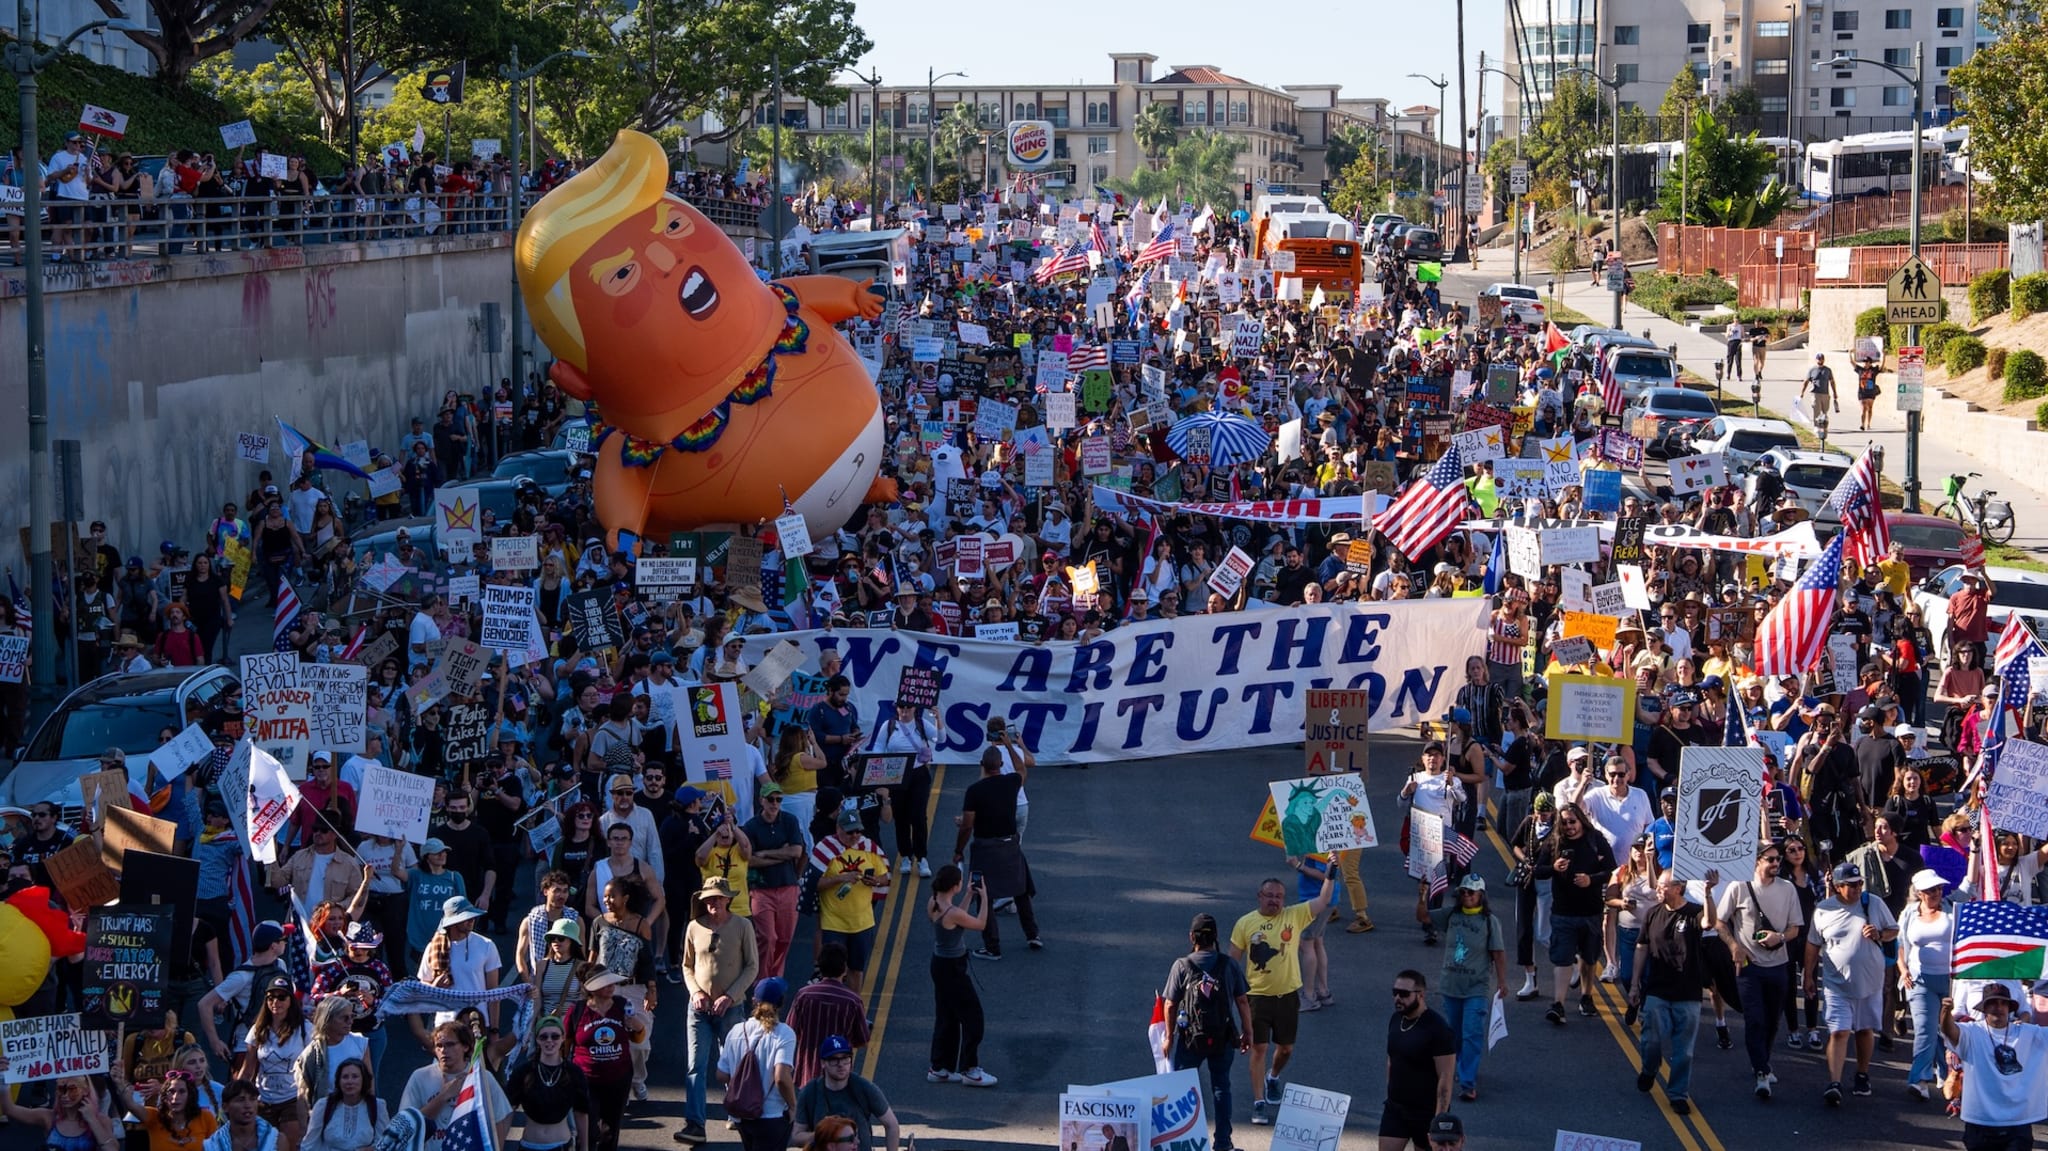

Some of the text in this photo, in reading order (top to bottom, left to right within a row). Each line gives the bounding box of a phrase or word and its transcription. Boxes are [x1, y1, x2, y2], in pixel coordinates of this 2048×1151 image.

[1014, 129, 1045, 143] BURGER
[1015, 138, 1047, 154] KING
[1512, 176, 1526, 185] 25
[6, 189, 22, 200] NO
[1892, 307, 1936, 318] AHEAD
[1240, 323, 1260, 333] NO
[1235, 336, 1259, 347] NAZI
[1236, 347, 1258, 357] KING
[1407, 376, 1424, 385] LIFE
[1407, 393, 1440, 402] JUSTICE
[239, 433, 269, 448] ABOLISH
[243, 446, 262, 460] ICE
[1551, 461, 1571, 475] NO
[1550, 472, 1580, 486] KINGS
[1621, 518, 1641, 531] ICE
[497, 539, 531, 550] PROTEST
[675, 540, 692, 549] TRY
[960, 540, 980, 549] KEEP
[1613, 544, 1640, 560] FUERA
[488, 588, 525, 603] TRUMP
[525, 591, 533, 604] &
[584, 597, 598, 609] AND
[942, 608, 961, 616] KEEP
[485, 617, 530, 630] GUILTY OF
[588, 624, 606, 637] CAME
[587, 635, 600, 646] FOR
[0, 649, 26, 663] OME
[814, 613, 1392, 693] WE ARE THE
[247, 652, 297, 677] RESIST
[448, 650, 481, 671] FIGHT
[301, 666, 320, 679] NOT
[333, 667, 351, 679] KING
[450, 664, 469, 681] THE
[906, 668, 932, 678] MAKE
[244, 670, 297, 694] REVOLT
[330, 678, 367, 694] PRESIDENT
[797, 676, 829, 695] YES
[900, 683, 937, 697] FICTION
[1574, 690, 1617, 699] IMMIGRATION
[257, 689, 311, 712] FOUNDER
[323, 692, 363, 707] DEFINITELY
[900, 693, 933, 706] AGAIN
[1310, 691, 1367, 709] LIBERTY
[277, 705, 289, 715] OF
[327, 704, 342, 712] THE
[449, 703, 488, 726] Fight
[312, 711, 364, 731] EPSTEIN
[1329, 708, 1341, 725] &
[256, 718, 310, 742] ANTIFA
[321, 727, 360, 745] FILES
[447, 720, 488, 742] Like A
[695, 722, 727, 737] RESIST
[1325, 742, 1345, 750] FOR
[1308, 751, 1363, 773] ALL
[369, 767, 399, 788] STEPHEN
[1710, 765, 1739, 783] College
[373, 787, 430, 808] YOUR HOMETOWN
[375, 802, 400, 818] HATES
[1325, 822, 1344, 832] THAT
[1317, 830, 1344, 842] WEARS
[1322, 841, 1349, 851] CROWN
[1692, 845, 1718, 859] Local
[432, 883, 455, 894] OUT
[100, 916, 153, 932] TRUMP HAS
[108, 934, 143, 947] SMALL
[103, 964, 160, 982] ENERGY!
[2, 1015, 79, 1039] BLONDE HAIR
[7, 1037, 37, 1052] EYED
[47, 1029, 108, 1061] APPALLED
[589, 1043, 623, 1055] CHIRLA
[1283, 1088, 1348, 1116] FEELING
[1064, 1100, 1136, 1119] FASCISM?
[1275, 1121, 1319, 1144] FRENCH
